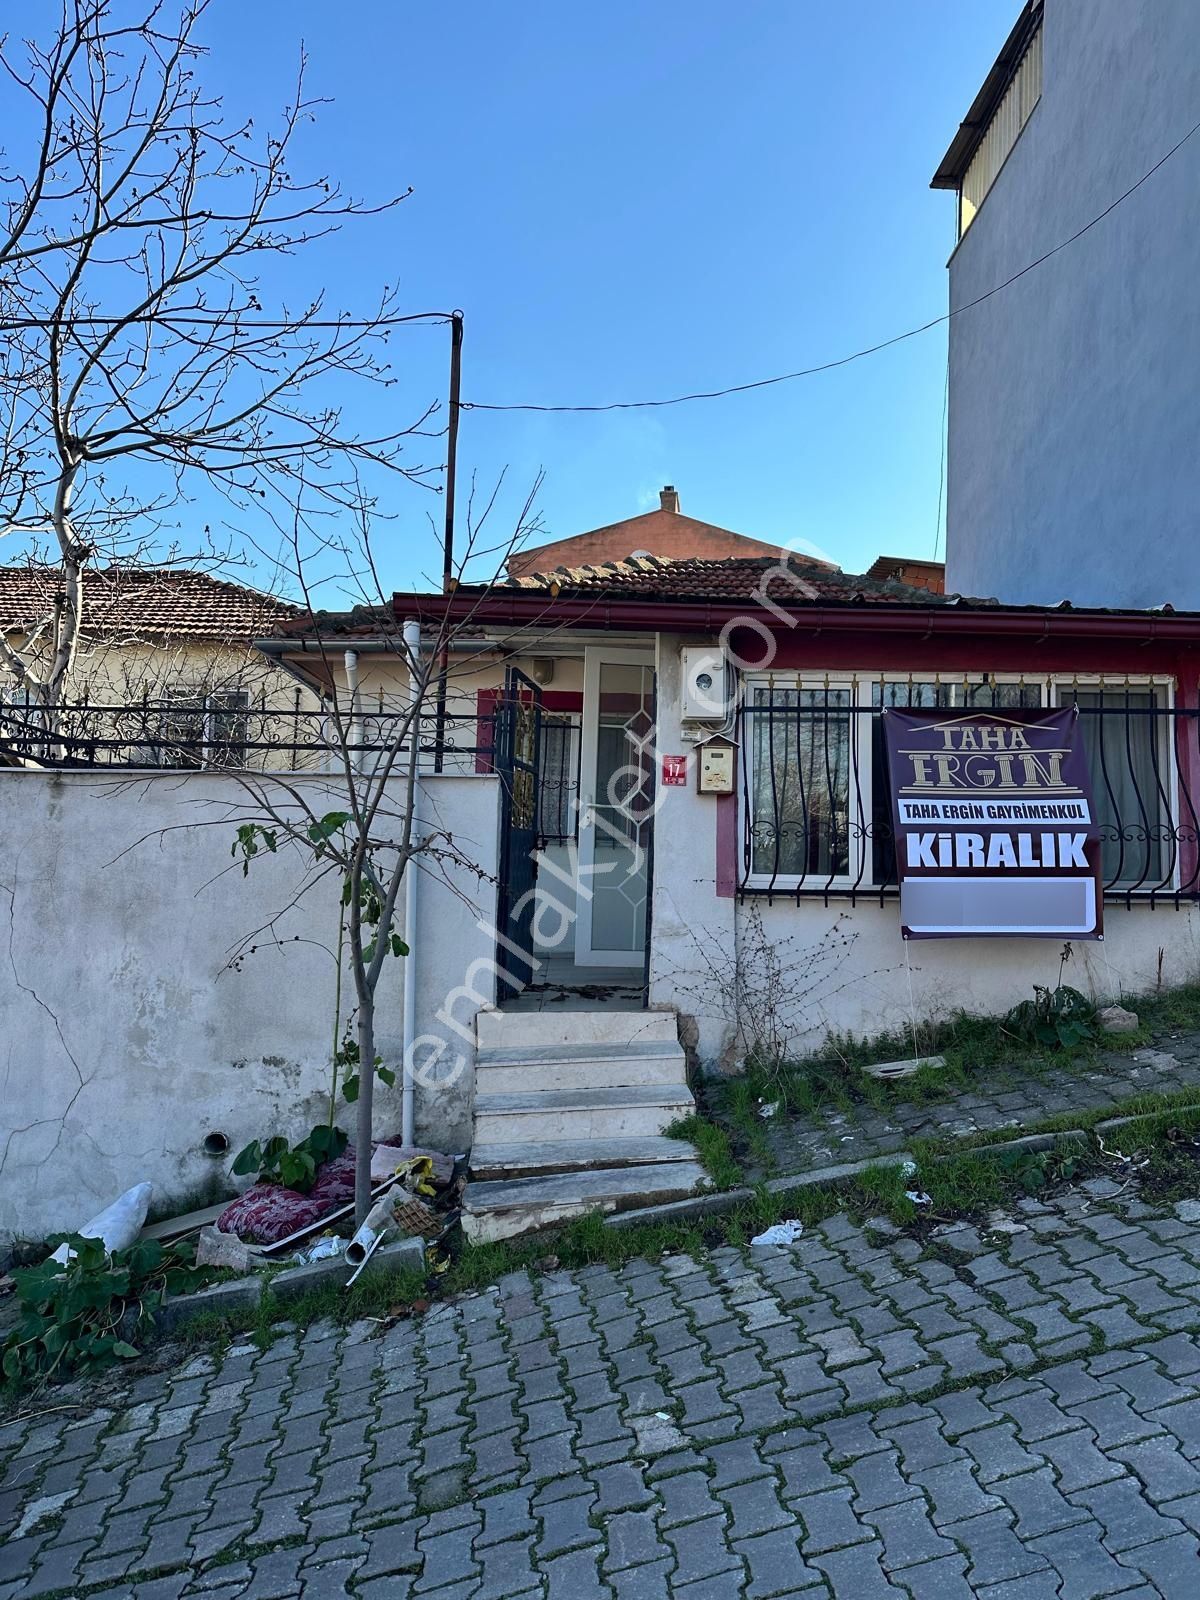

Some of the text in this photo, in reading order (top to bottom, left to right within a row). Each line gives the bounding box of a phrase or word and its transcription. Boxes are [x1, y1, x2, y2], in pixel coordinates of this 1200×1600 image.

[933, 726, 1031, 750] TAHA
[669, 763, 680, 777] 17
[904, 802, 1085, 820] TAHA ERGİN GAYRİMENKUL
